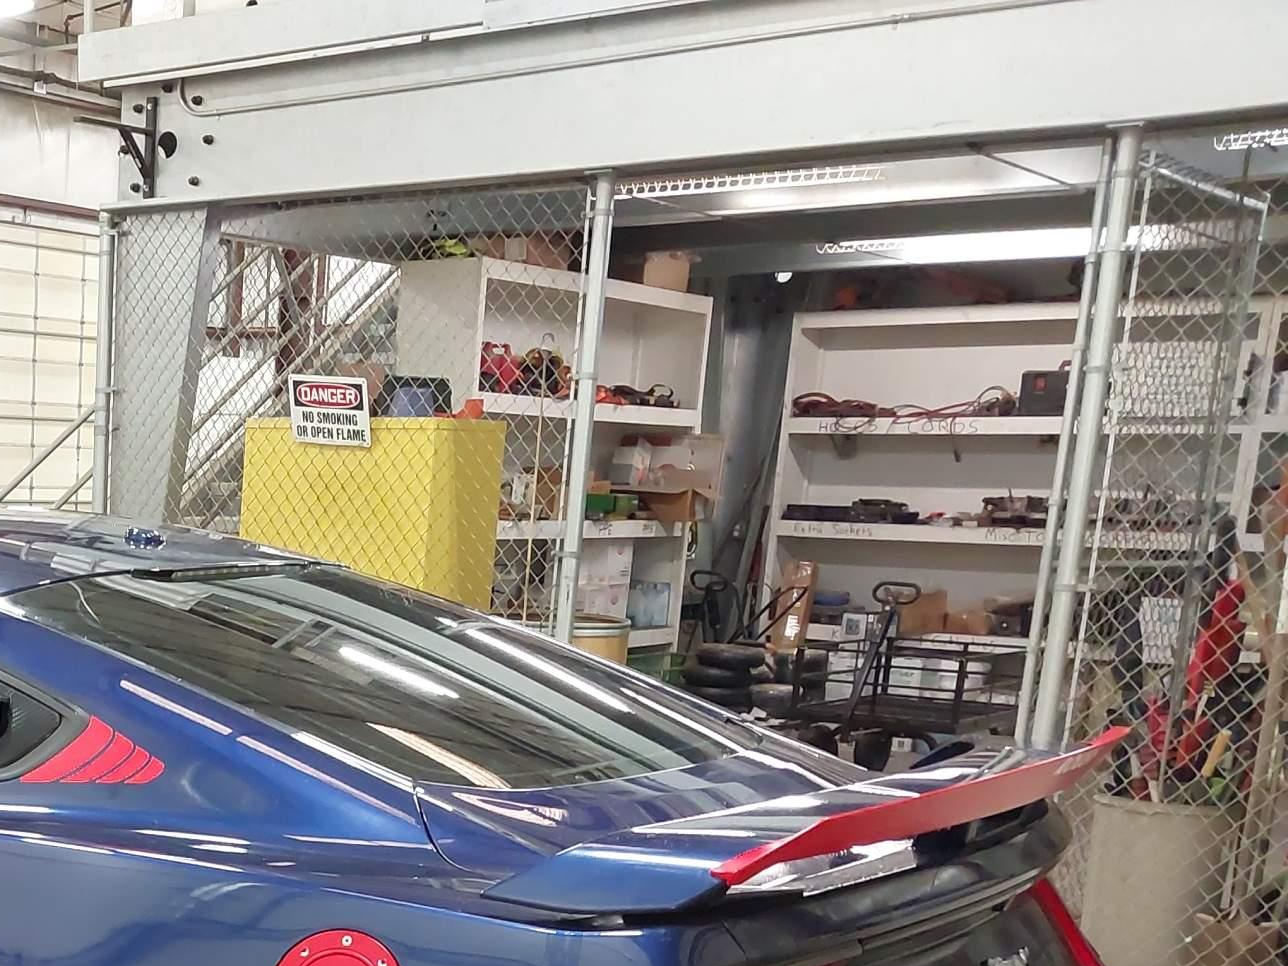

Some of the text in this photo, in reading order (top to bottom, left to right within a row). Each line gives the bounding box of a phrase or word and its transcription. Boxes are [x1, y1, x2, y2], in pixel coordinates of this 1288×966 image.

[300, 386, 356, 404] DANGER
[302, 410, 358, 426] NO SMOKING
[297, 425, 367, 442] OR OPEN FLAME
